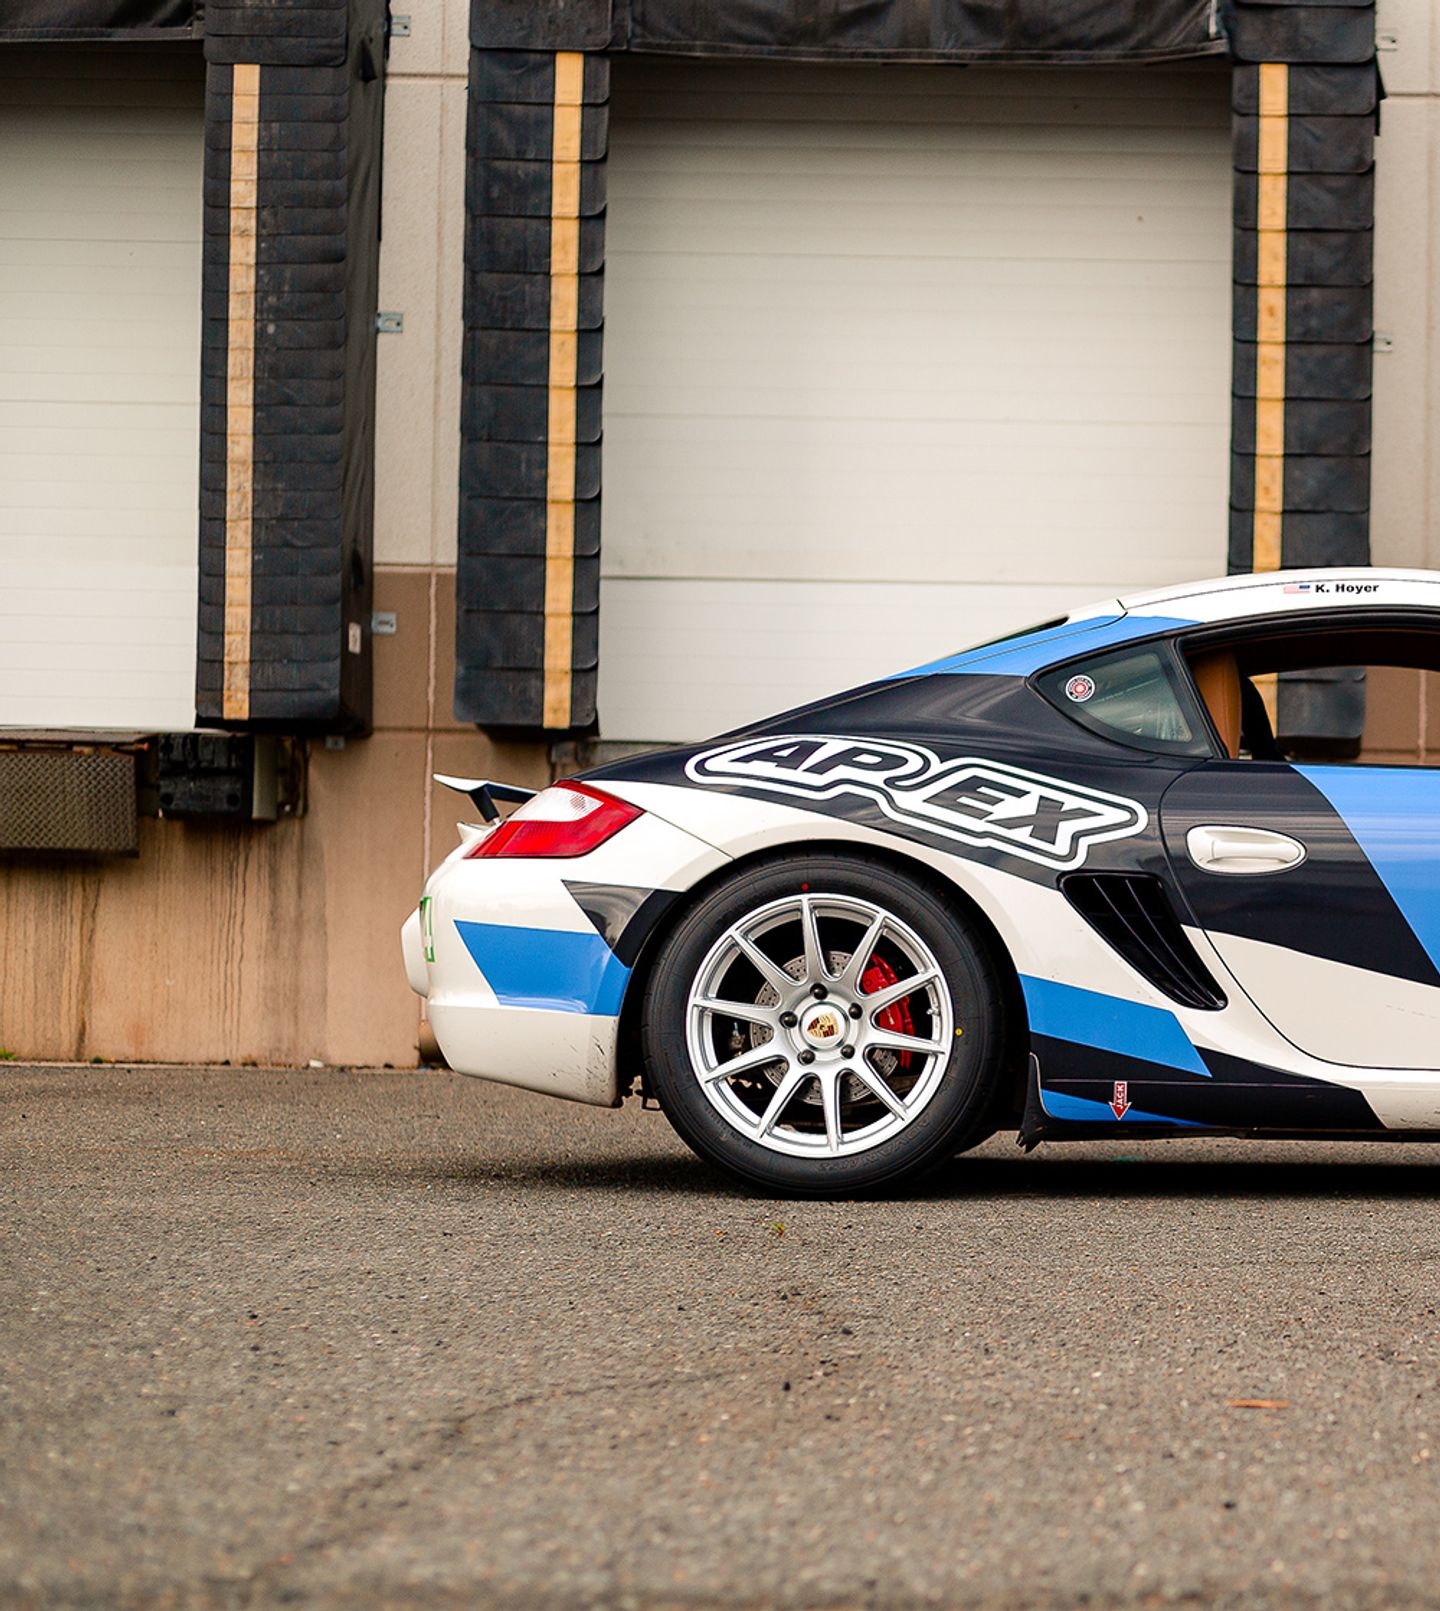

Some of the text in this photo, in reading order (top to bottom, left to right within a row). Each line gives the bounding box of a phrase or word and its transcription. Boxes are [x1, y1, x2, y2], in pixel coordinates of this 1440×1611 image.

[1315, 583, 1379, 594] K. Hoyer
[1117, 1084, 1125, 1109] JACK
